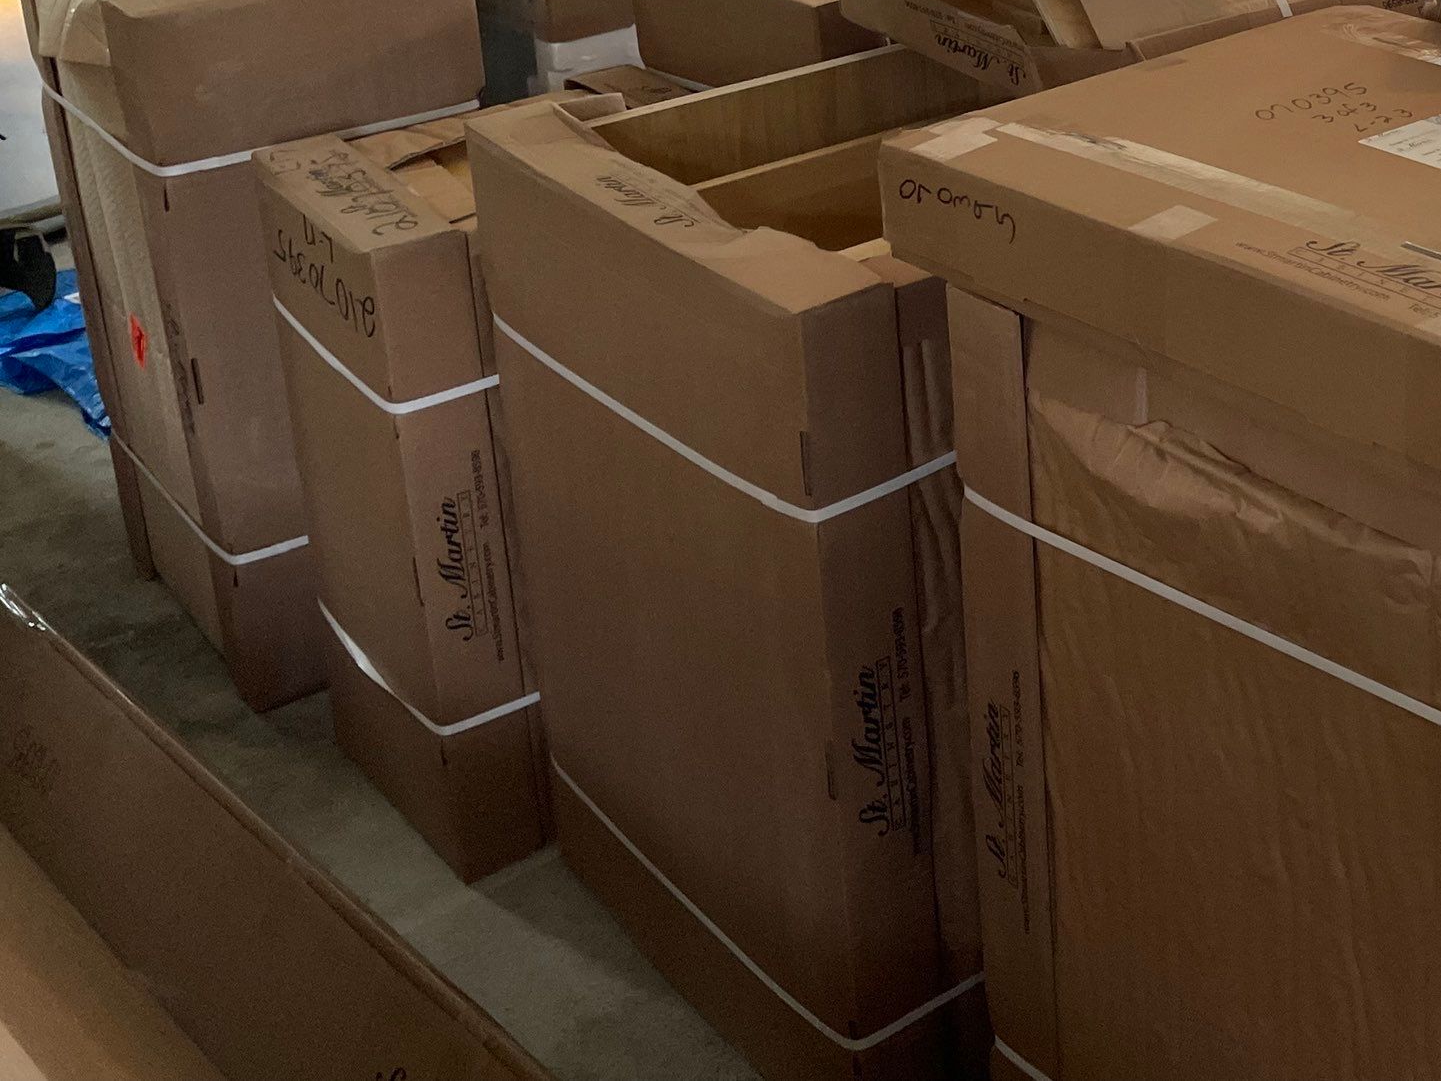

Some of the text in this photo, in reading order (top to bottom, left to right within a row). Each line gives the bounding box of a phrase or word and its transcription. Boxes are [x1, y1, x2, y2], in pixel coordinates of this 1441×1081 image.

[934, 32, 1001, 72] Martin
[436, 495, 469, 599] Martin
[852, 664, 885, 788] Martin
